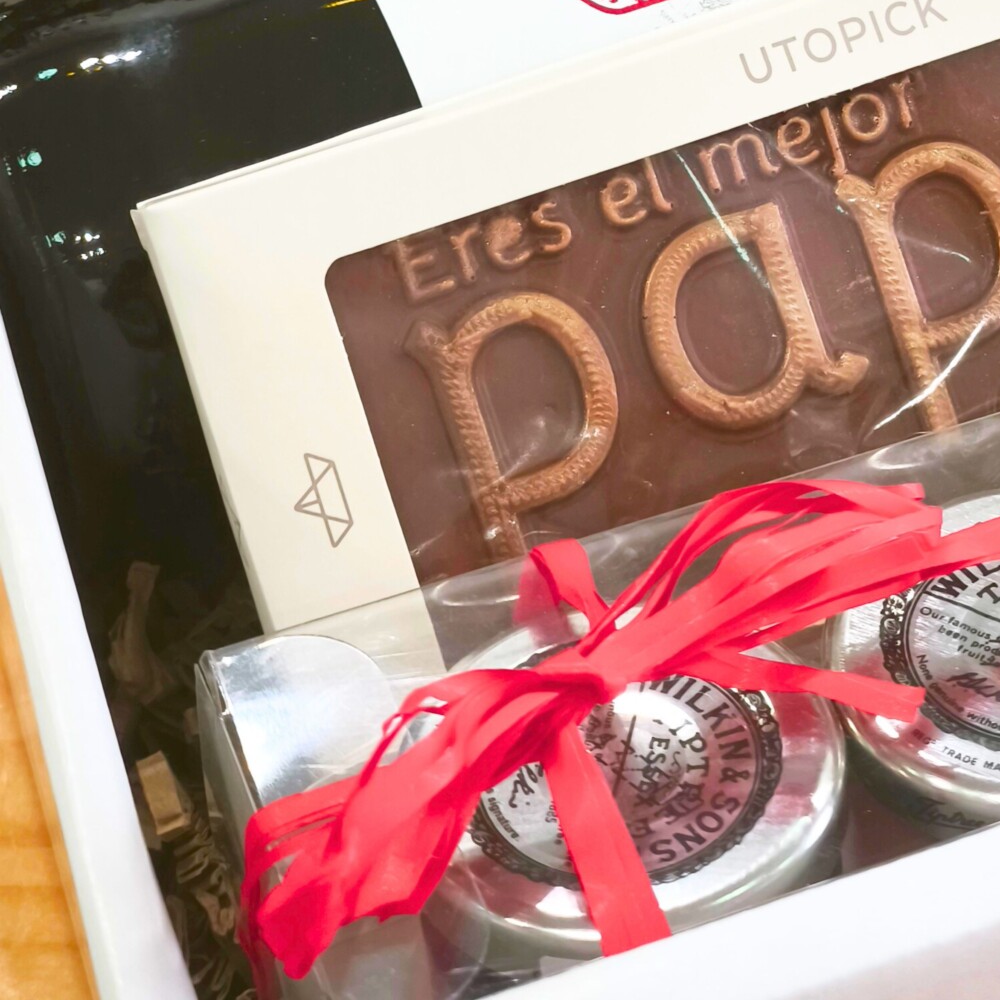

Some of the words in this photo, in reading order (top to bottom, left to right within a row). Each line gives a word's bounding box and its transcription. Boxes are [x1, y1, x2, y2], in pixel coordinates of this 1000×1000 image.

[397, 200, 573, 299] Eres
[602, 157, 673, 226] el
[699, 74, 915, 190] mejor
[919, 605, 944, 621] Our
[947, 615, 991, 639] famous
[917, 654, 932, 681] None
[940, 745, 976, 766] TRADE
[722, 763, 750, 784] &
[649, 791, 739, 862] SONS
